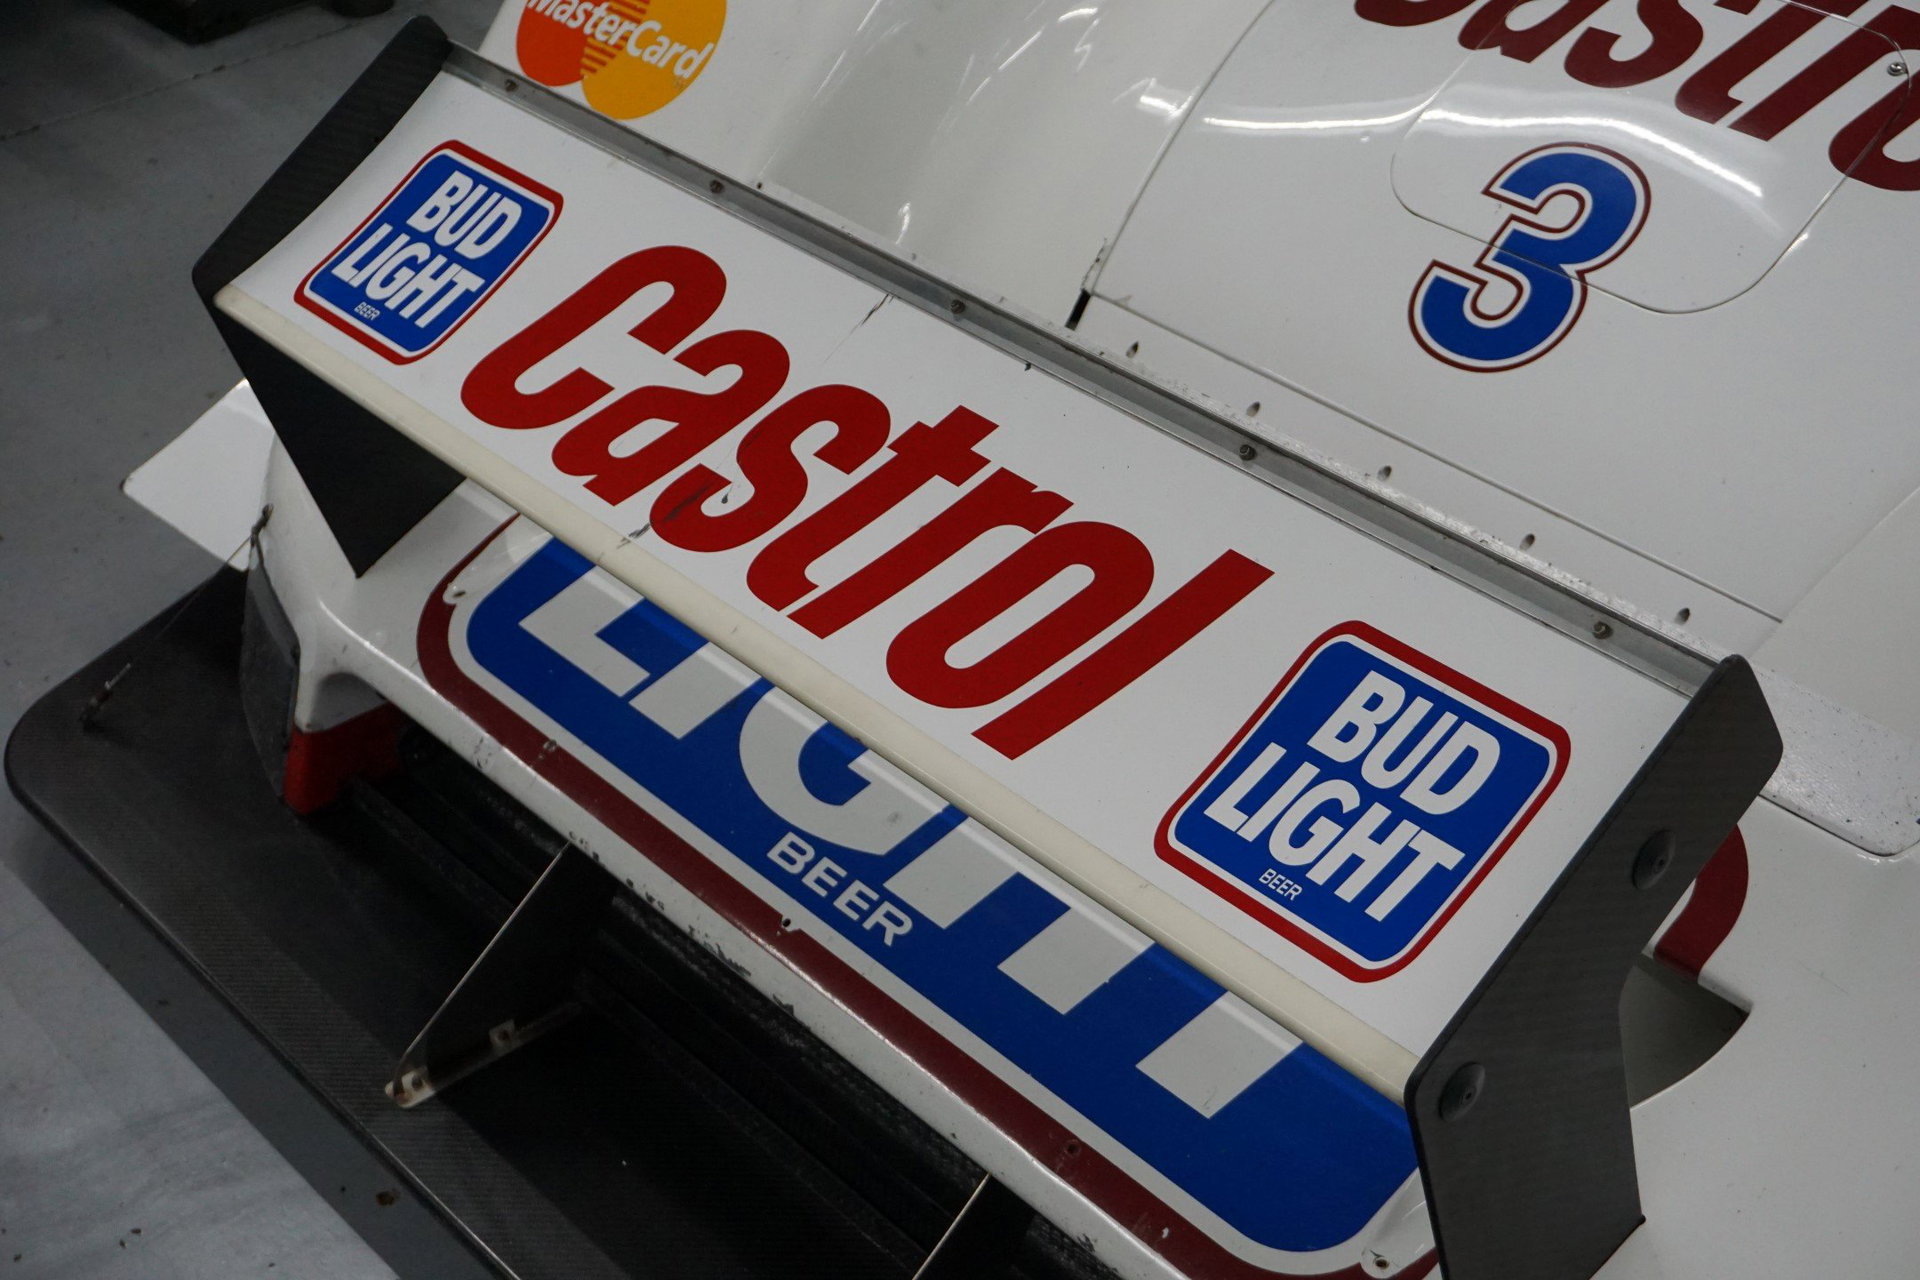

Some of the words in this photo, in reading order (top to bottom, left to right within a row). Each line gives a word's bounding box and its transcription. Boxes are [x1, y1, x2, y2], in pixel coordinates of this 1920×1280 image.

[406, 170, 522, 260] BUD
[1408, 141, 1652, 373] 3
[331, 222, 486, 329] LIGHT
[354, 301, 381, 321] BEER
[461, 245, 1275, 760] Castrol
[1306, 669, 1501, 815] BUD
[767, 832, 914, 947] BEER
[1203, 742, 1466, 922] LIGHT
[1258, 868, 1303, 901] BEER
